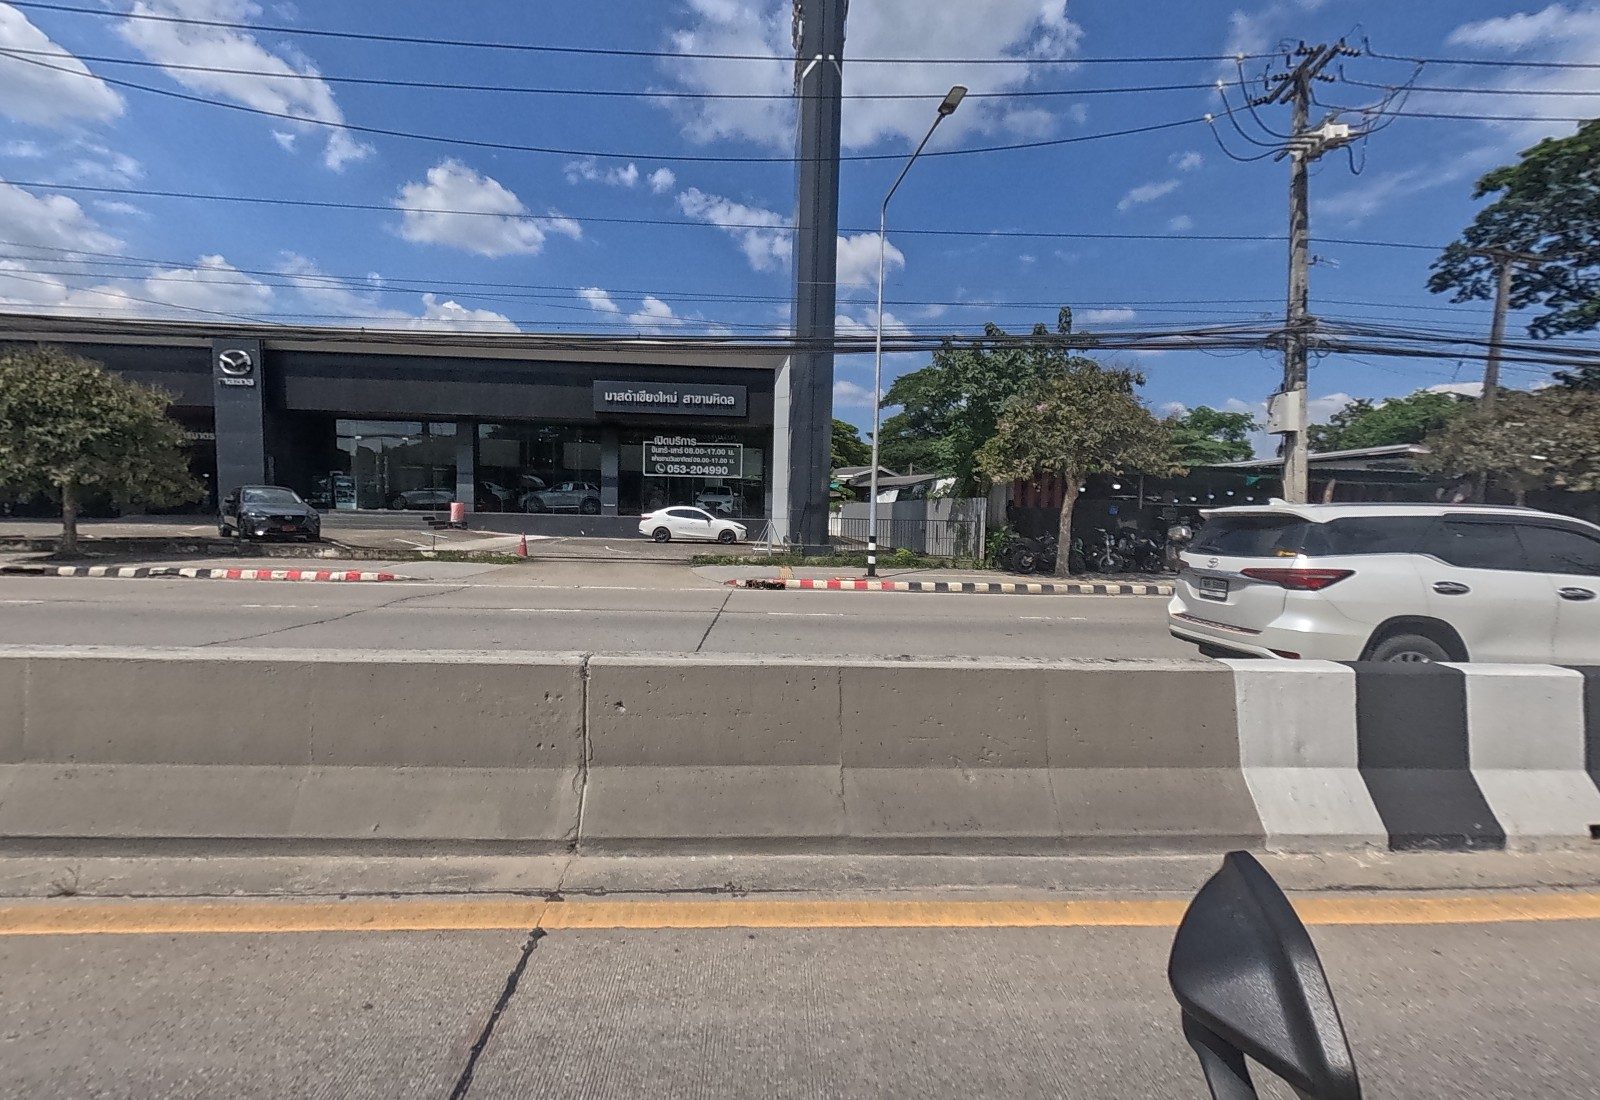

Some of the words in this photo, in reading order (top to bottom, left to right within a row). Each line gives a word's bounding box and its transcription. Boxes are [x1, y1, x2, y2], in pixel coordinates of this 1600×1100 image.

[604, 389, 678, 404] มาสด้าเชียงใหม่
[682, 393, 735, 405] สาขามหิดล
[654, 435, 697, 446] เปิดบริการ
[684, 447, 726, 456] 08.00-17.00
[667, 464, 729, 475] 053-204990
